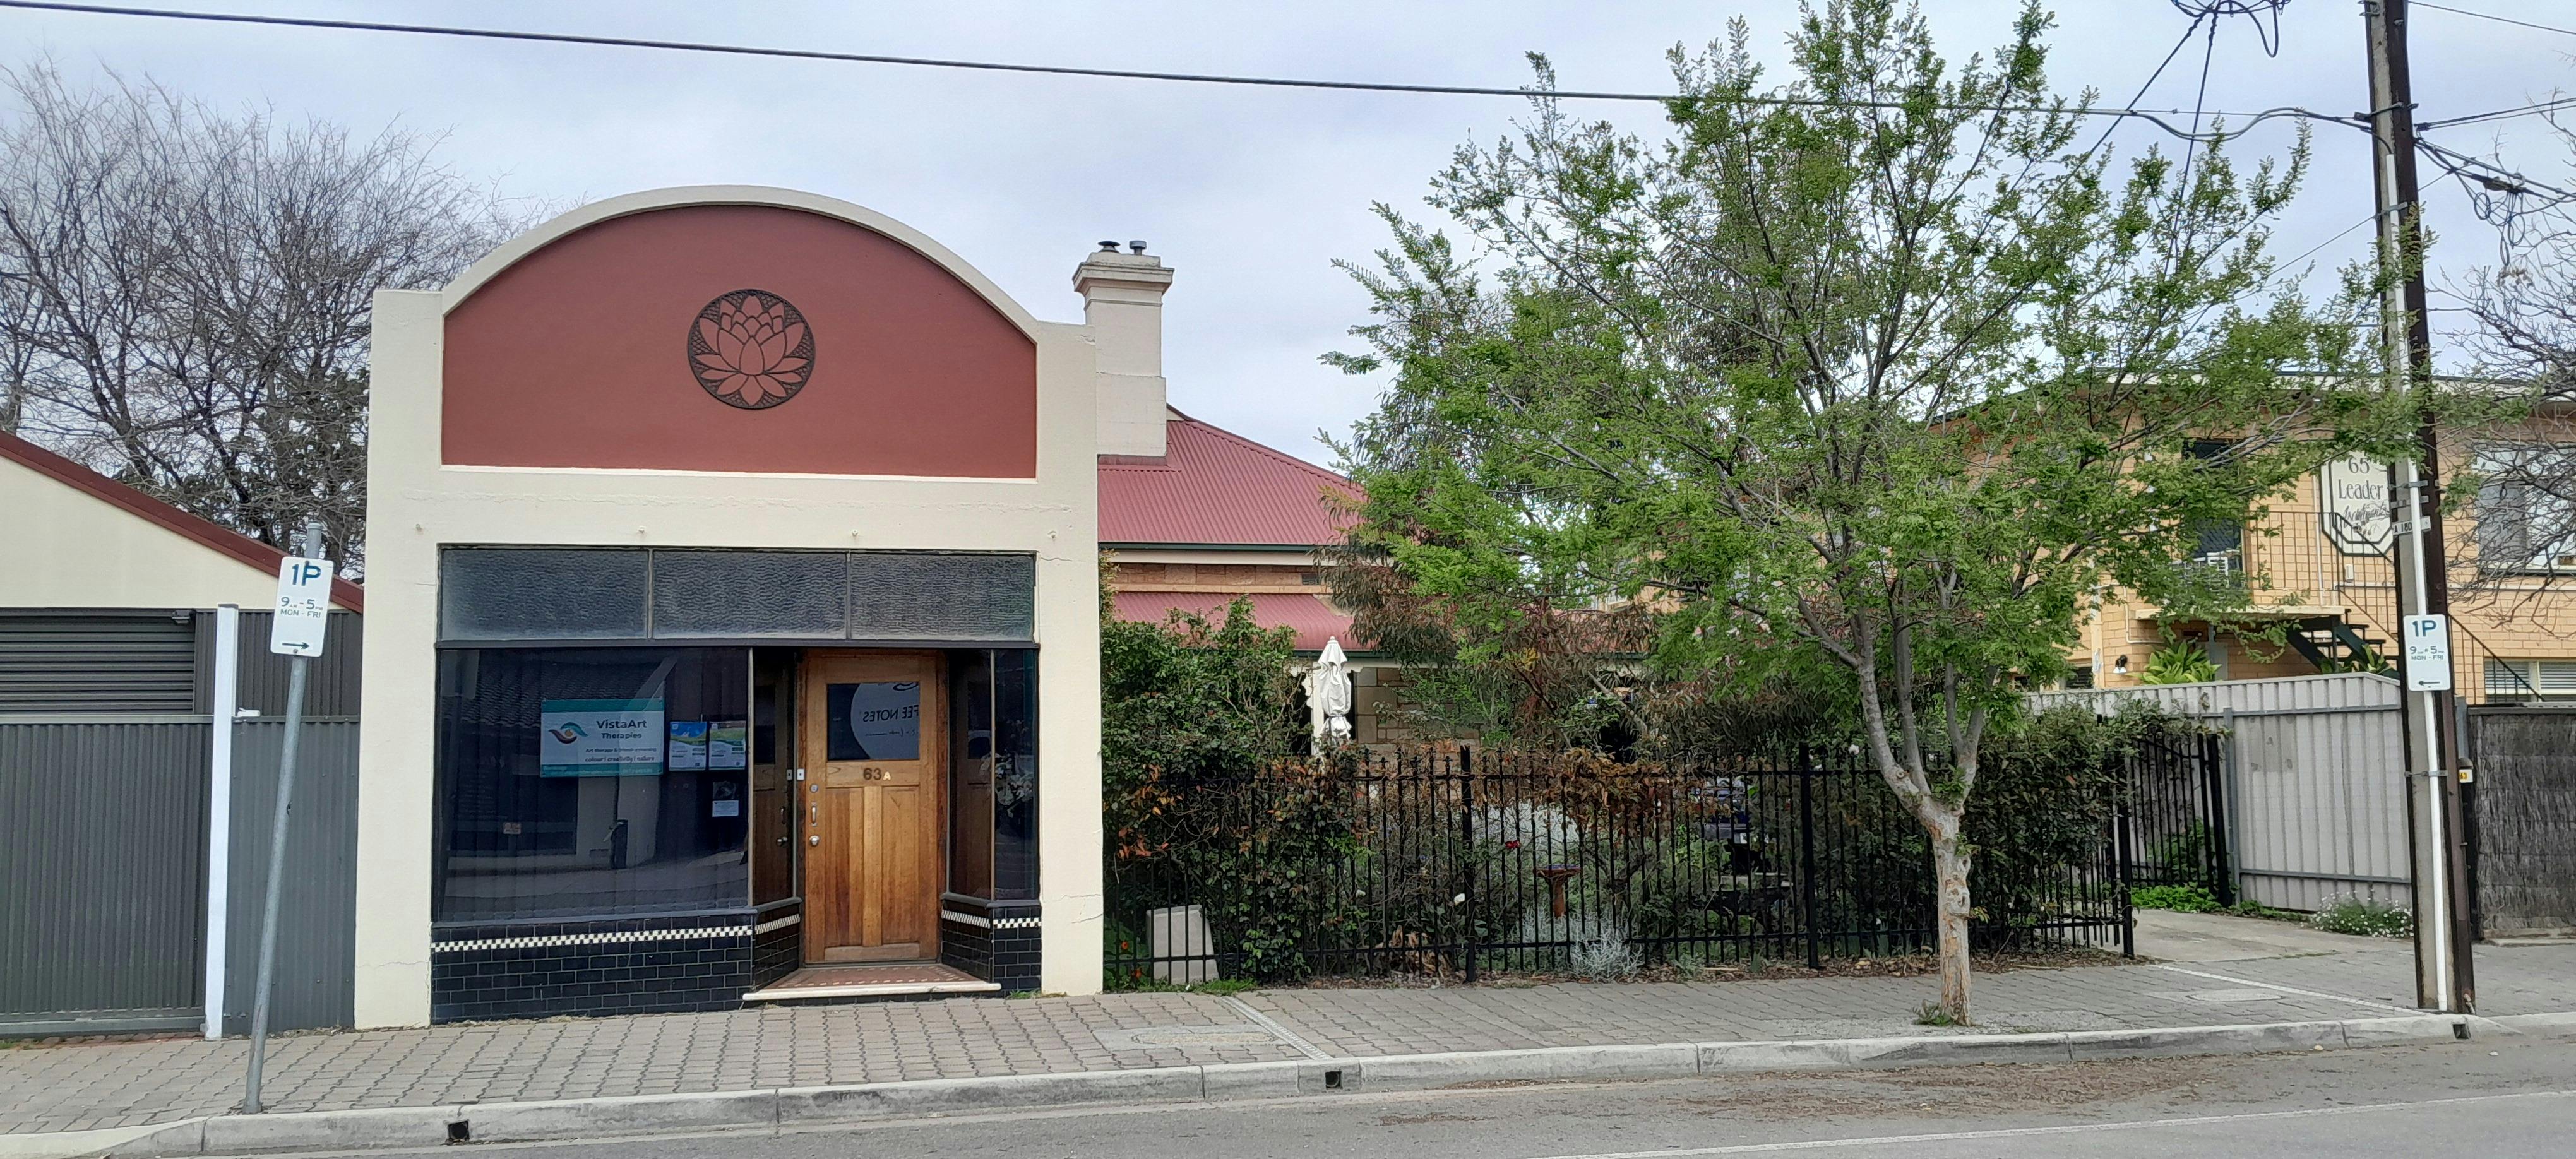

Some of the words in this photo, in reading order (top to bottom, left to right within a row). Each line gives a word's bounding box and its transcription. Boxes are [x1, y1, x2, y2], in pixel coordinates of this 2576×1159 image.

[2348, 457, 2370, 473] 65
[2338, 479, 2383, 500] Leader
[292, 564, 321, 586] 1P
[307, 610, 321, 619] FRI
[2412, 620, 2436, 637] 1P
[596, 719, 647, 728] VistaArt
